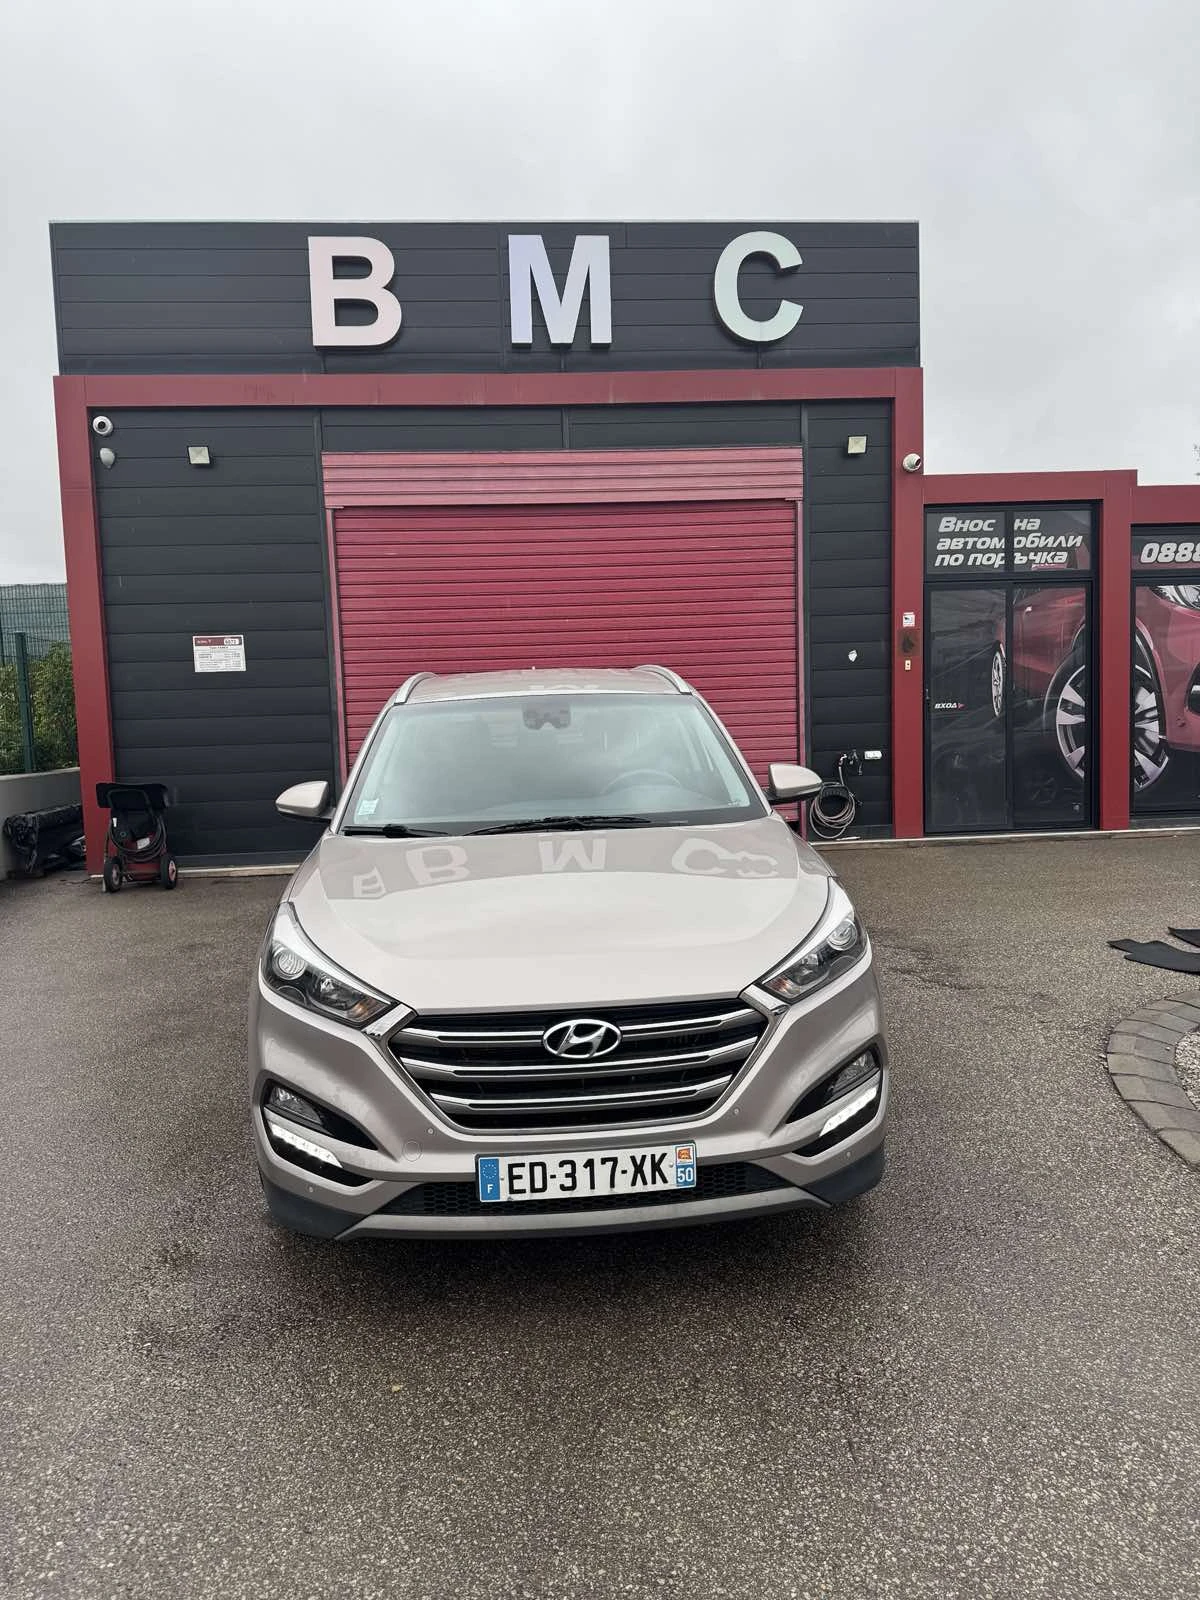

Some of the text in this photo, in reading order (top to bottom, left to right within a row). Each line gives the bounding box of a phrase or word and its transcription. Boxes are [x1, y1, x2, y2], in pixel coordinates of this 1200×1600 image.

[938, 516, 1041, 532] Внос на
[934, 553, 965, 567] по
[487, 1152, 694, 1195] F ED-317-XK 50
